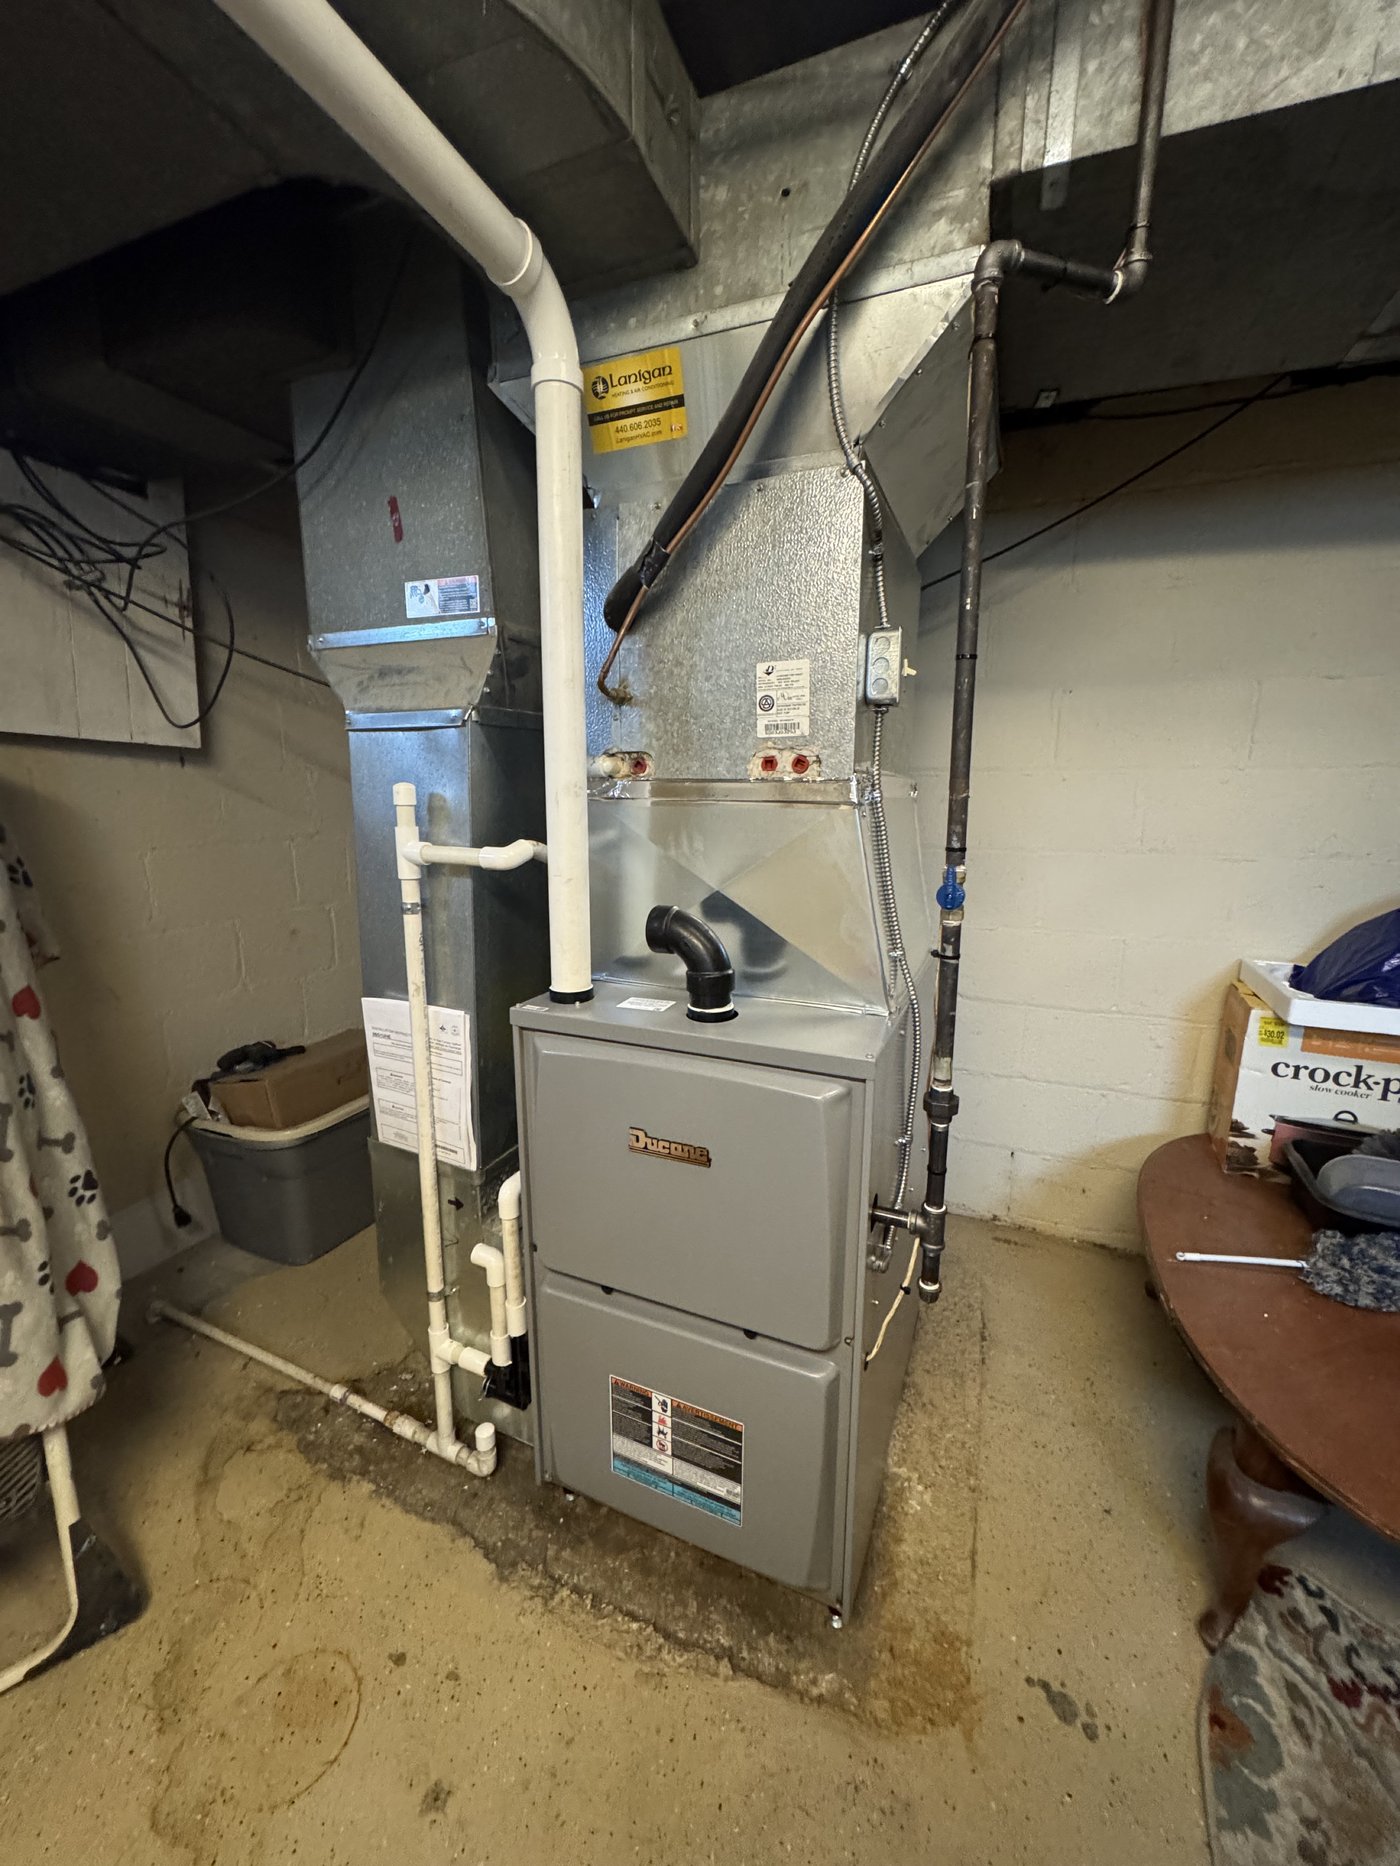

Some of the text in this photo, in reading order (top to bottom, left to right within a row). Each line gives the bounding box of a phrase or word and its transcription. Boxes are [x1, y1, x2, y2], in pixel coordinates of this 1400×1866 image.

[609, 365, 672, 388] Lanigan
[612, 389, 631, 398] HEATING
[616, 418, 662, 433] 440.606.2035
[1309, 1084, 1372, 1099] slow cooker
[628, 1126, 709, 1162] Ducane
